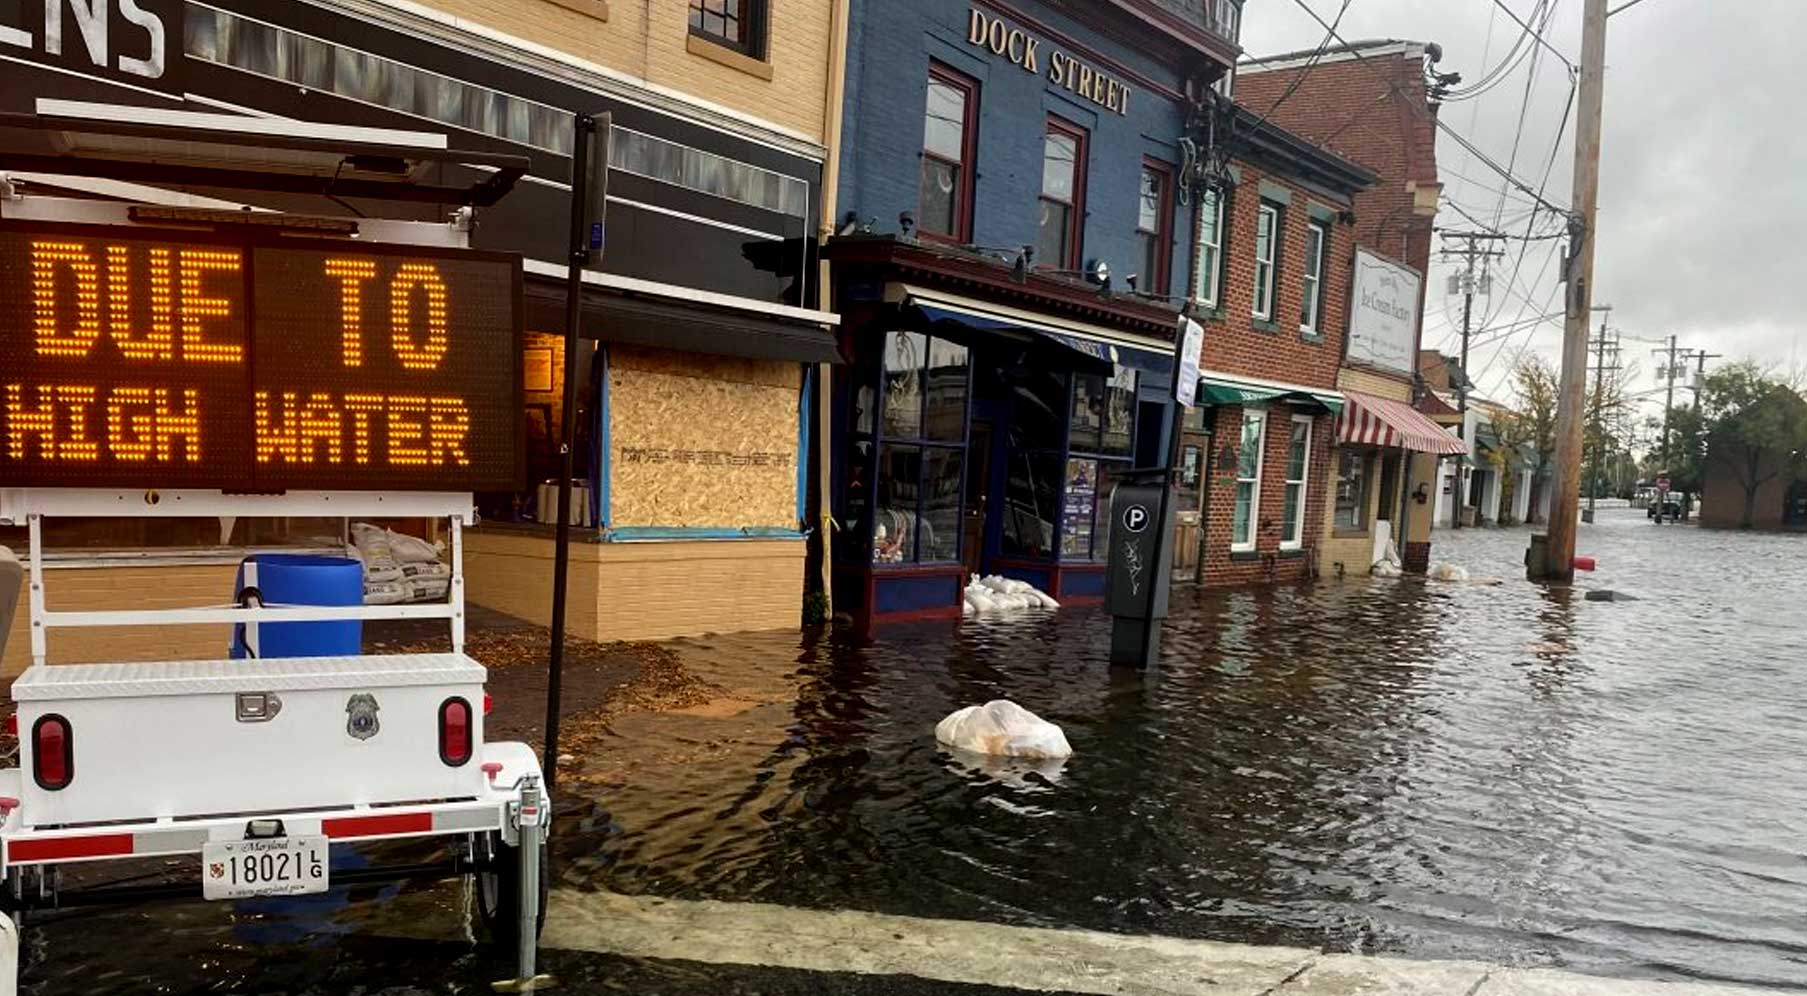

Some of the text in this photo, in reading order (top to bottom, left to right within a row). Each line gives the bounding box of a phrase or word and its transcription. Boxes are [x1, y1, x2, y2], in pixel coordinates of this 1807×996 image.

[0, 0, 165, 79] NS
[969, 8, 1131, 116] DOCK STREET
[32, 241, 448, 369] DUE TO
[6, 384, 470, 465] HIGH WATER
[1130, 509, 1144, 527] P
[230, 852, 301, 885] 18021
